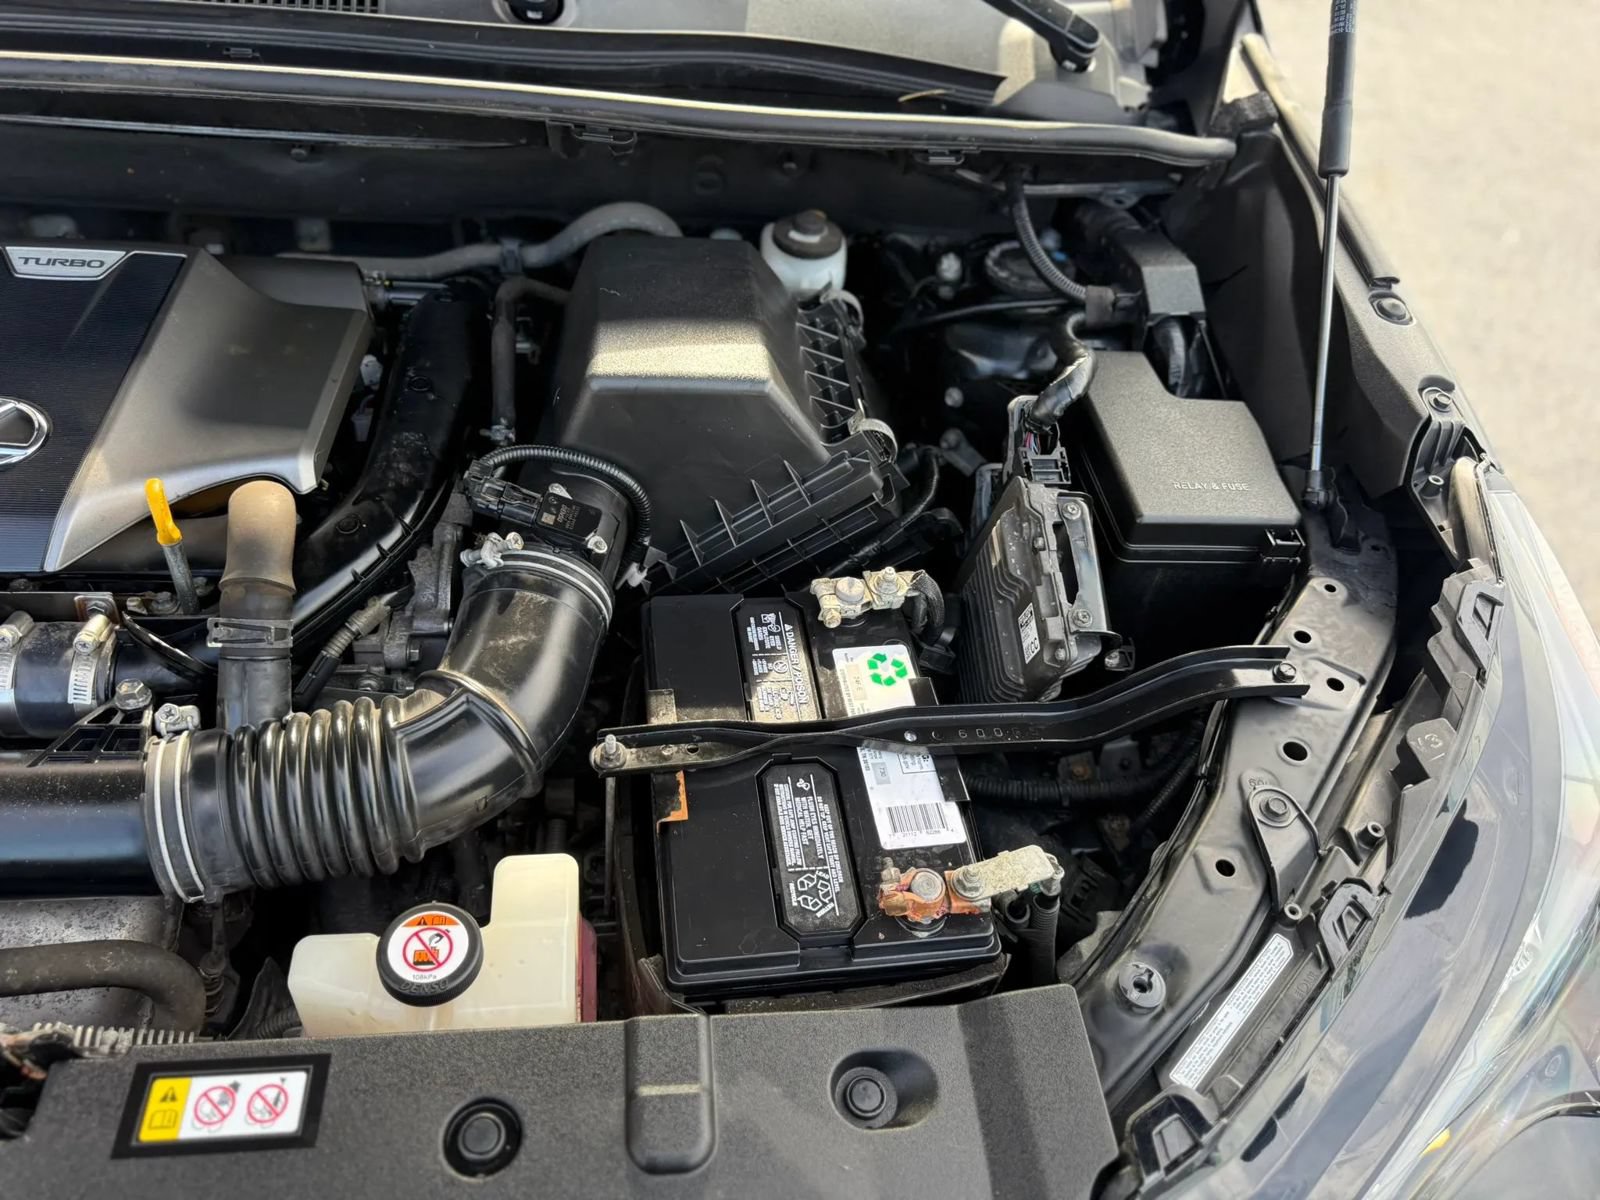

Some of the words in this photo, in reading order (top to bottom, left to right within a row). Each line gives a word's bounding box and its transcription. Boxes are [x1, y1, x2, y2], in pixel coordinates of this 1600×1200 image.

[18, 256, 106, 268] TURBO
[1173, 481, 1208, 490] RELAY
[1210, 482, 1220, 490] &
[1221, 482, 1250, 491] FUSE
[400, 979, 449, 993] DENSO
